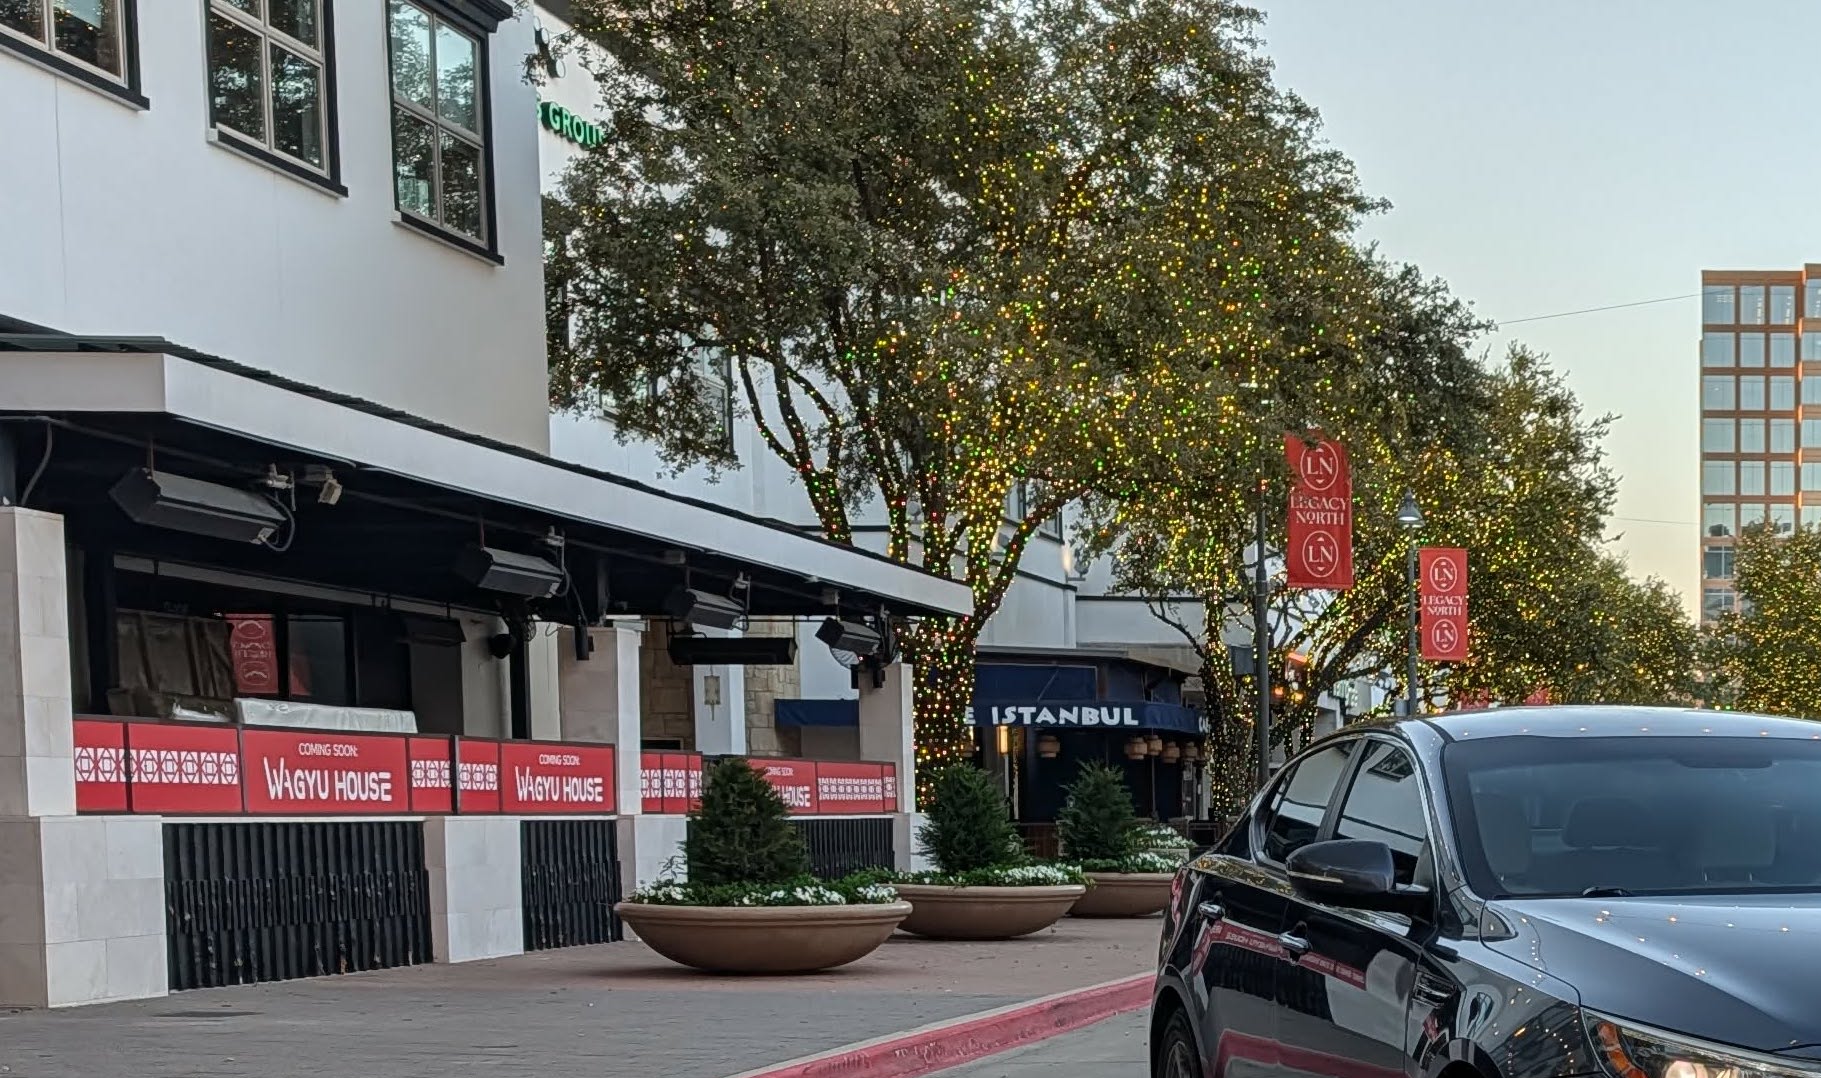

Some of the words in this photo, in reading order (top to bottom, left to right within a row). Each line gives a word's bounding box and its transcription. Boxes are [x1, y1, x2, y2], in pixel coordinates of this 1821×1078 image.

[1306, 456, 1334, 475] LN
[1290, 495, 1348, 510] LEGACY
[1296, 511, 1345, 526] NORTH
[1308, 545, 1334, 563] LN
[1434, 567, 1454, 581] LN
[1423, 595, 1463, 606] LEGACY
[1427, 606, 1462, 616] NORTH
[1435, 629, 1454, 643] LN
[991, 705, 1139, 726] ISTANBUL
[298, 742, 332, 756] COMING
[539, 754, 562, 766] COMING
[263, 756, 329, 800] WAGYU
[334, 769, 393, 801] HOUSE
[514, 765, 560, 802] WAGYU
[562, 775, 604, 803] HOUSE
